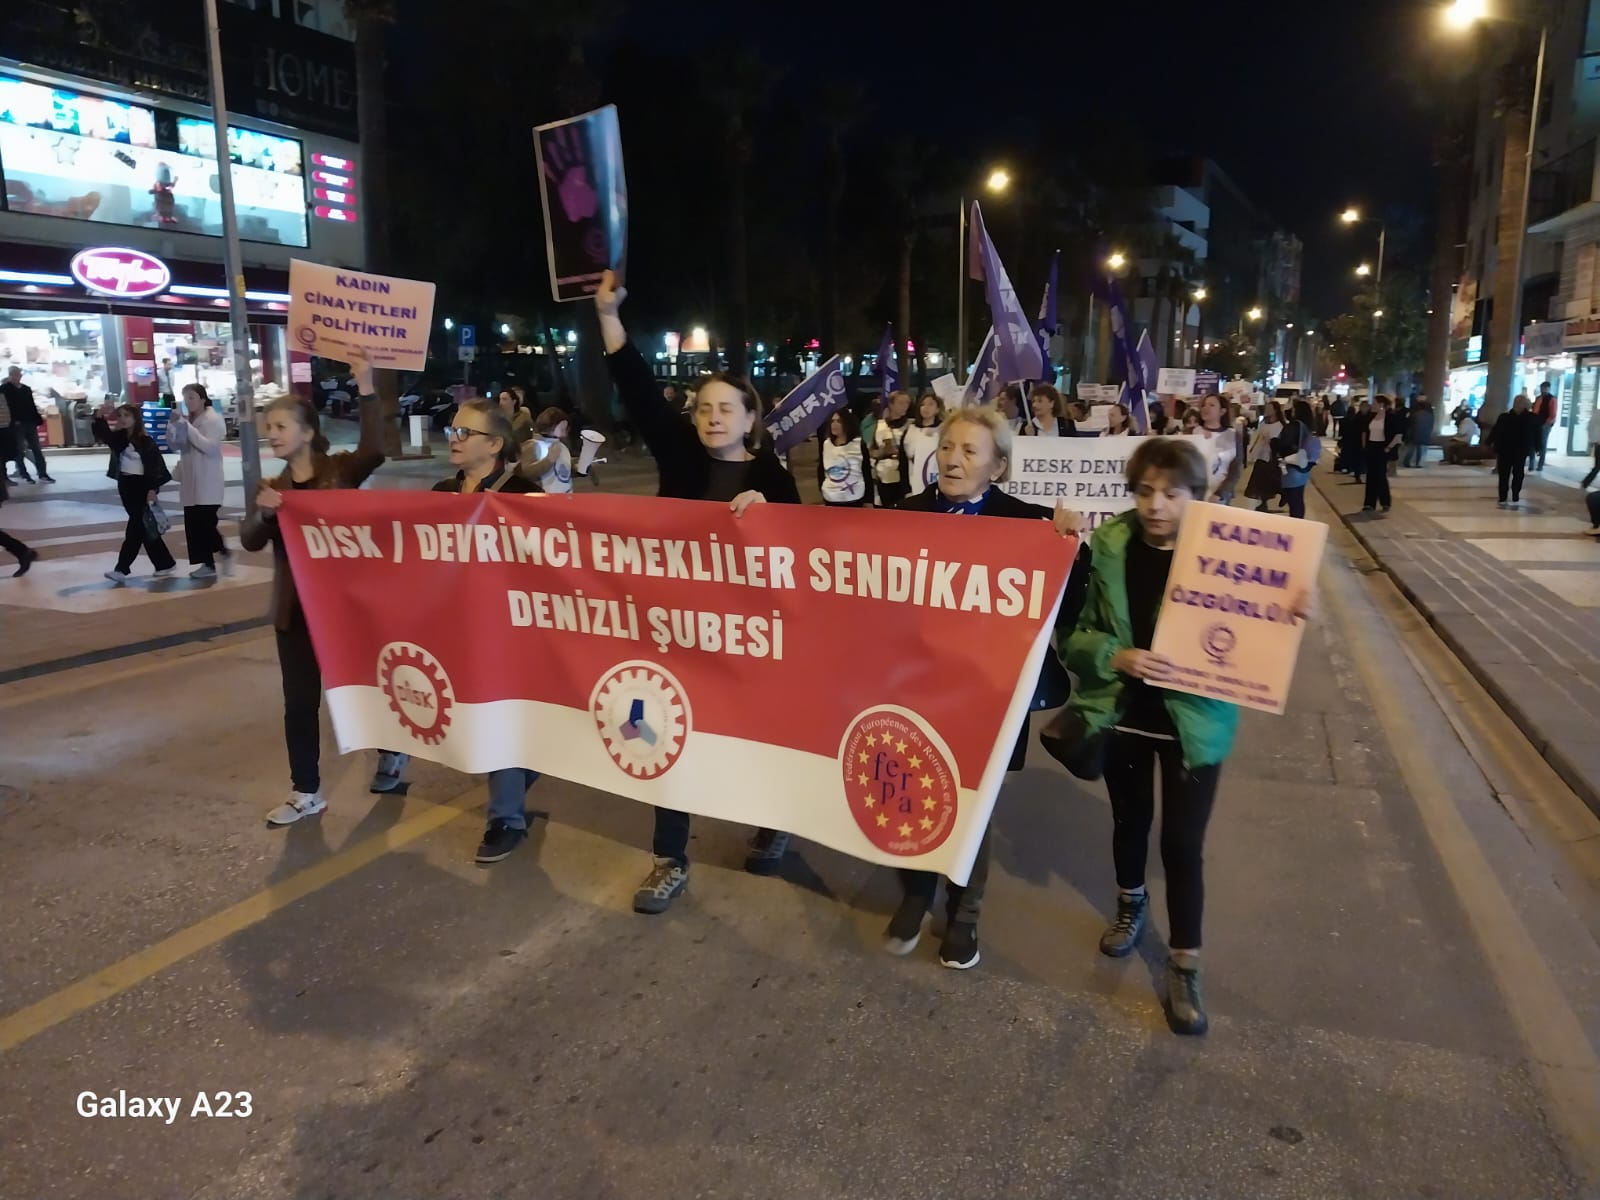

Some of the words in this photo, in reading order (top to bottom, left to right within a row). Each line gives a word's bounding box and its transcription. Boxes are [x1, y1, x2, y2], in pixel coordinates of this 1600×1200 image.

[249, 42, 352, 110] HOME
[336, 275, 390, 294] KADIN
[304, 291, 417, 319] CİNAYETLERİ
[312, 314, 407, 339] POLİTİKTİR
[462, 327, 471, 344] P
[766, 393, 820, 440] KESK
[1022, 458, 1072, 474] KESK
[1209, 521, 1293, 552] KADIN
[301, 518, 383, 558] DİSK
[413, 517, 582, 569] DEVRİMCİ
[591, 532, 796, 589] EMEKLİLER
[808, 548, 1046, 619] SENDİKASI
[1198, 555, 1289, 590] YAŞAM
[507, 589, 640, 641] DENİZLİ
[647, 606, 783, 660] ŞUBESİ
